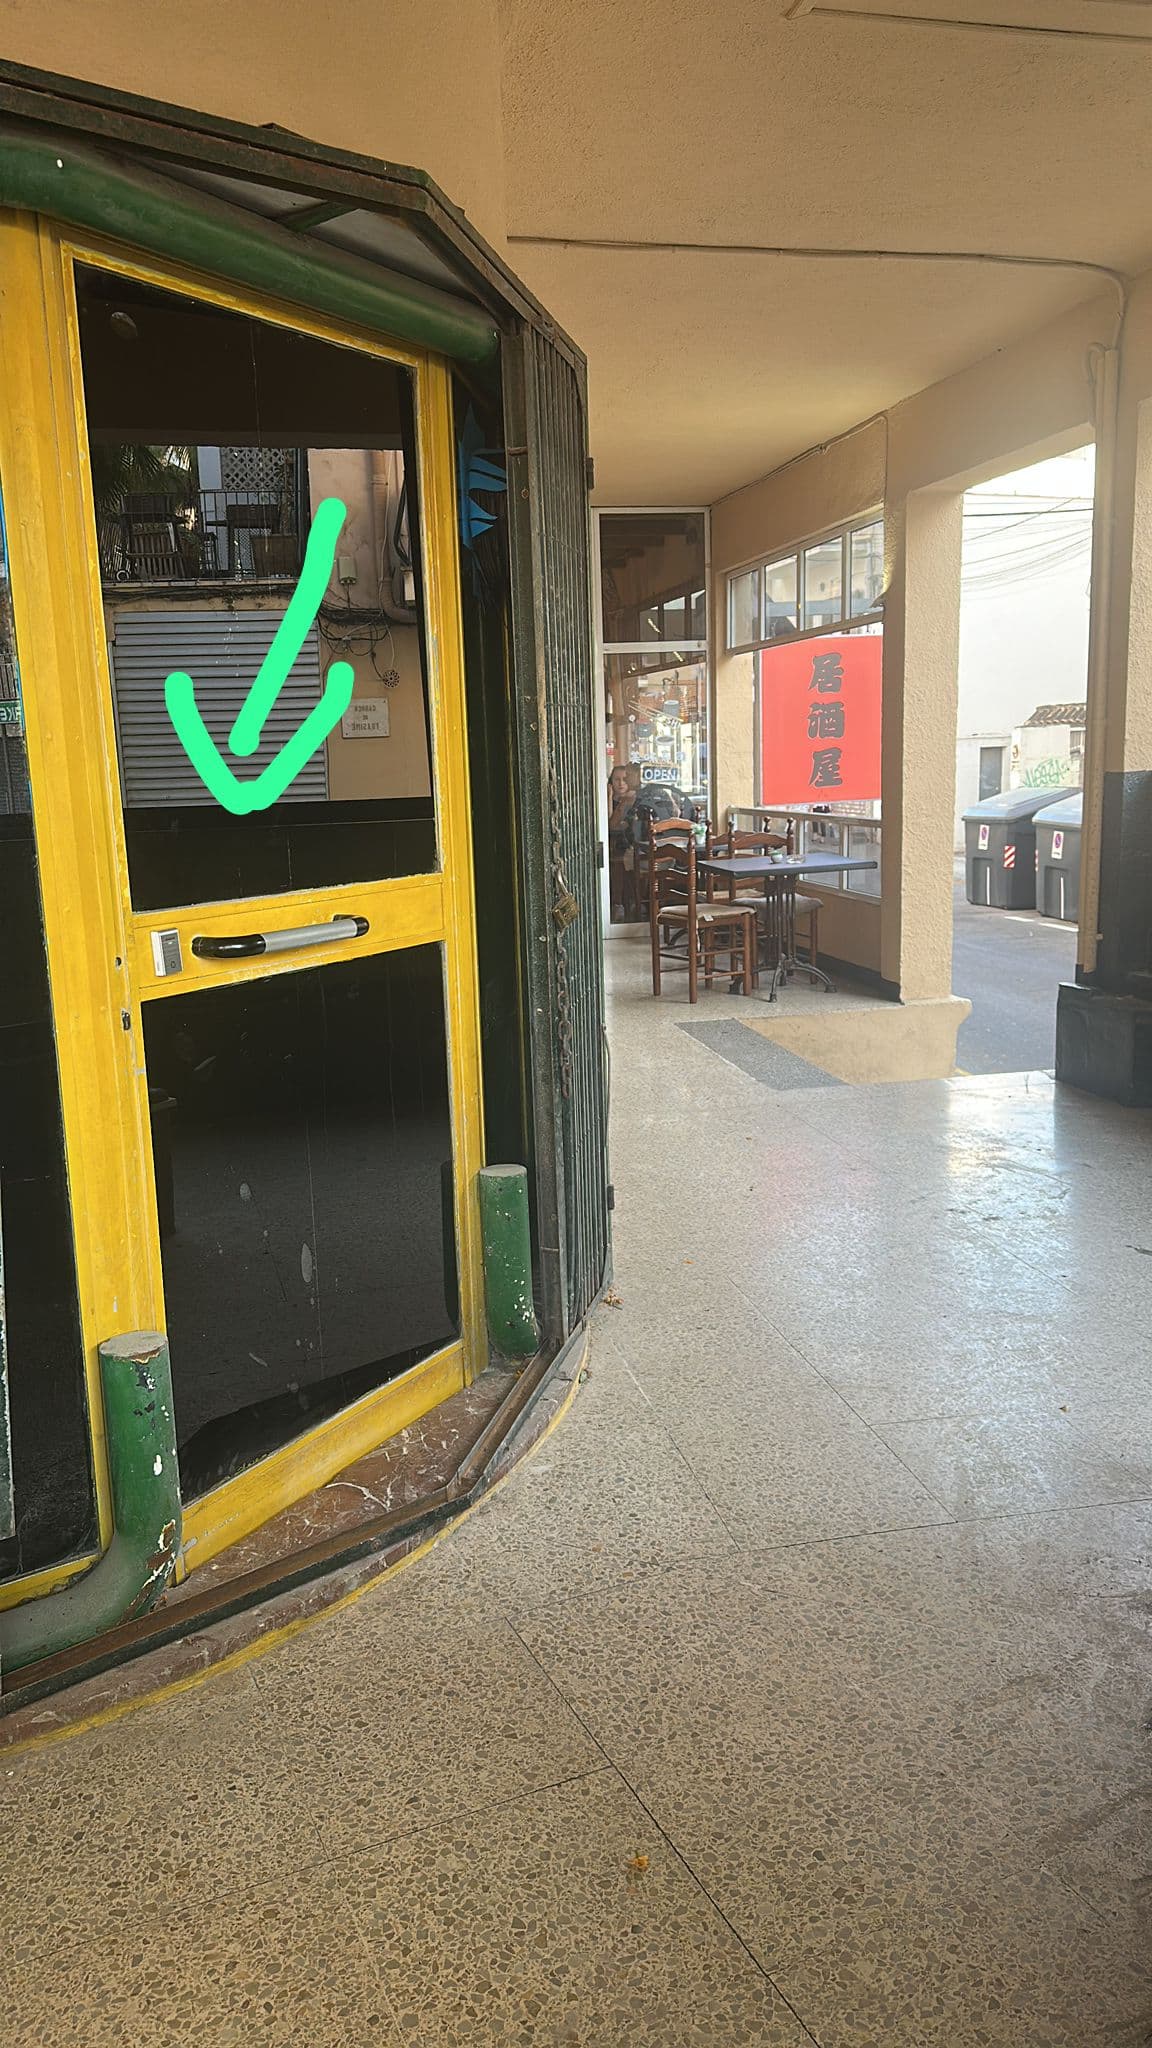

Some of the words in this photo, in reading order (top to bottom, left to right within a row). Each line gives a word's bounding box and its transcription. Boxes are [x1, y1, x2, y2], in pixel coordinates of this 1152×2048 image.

[807, 652, 845, 788] 居酒屋
[644, 769, 677, 781] OPEN
